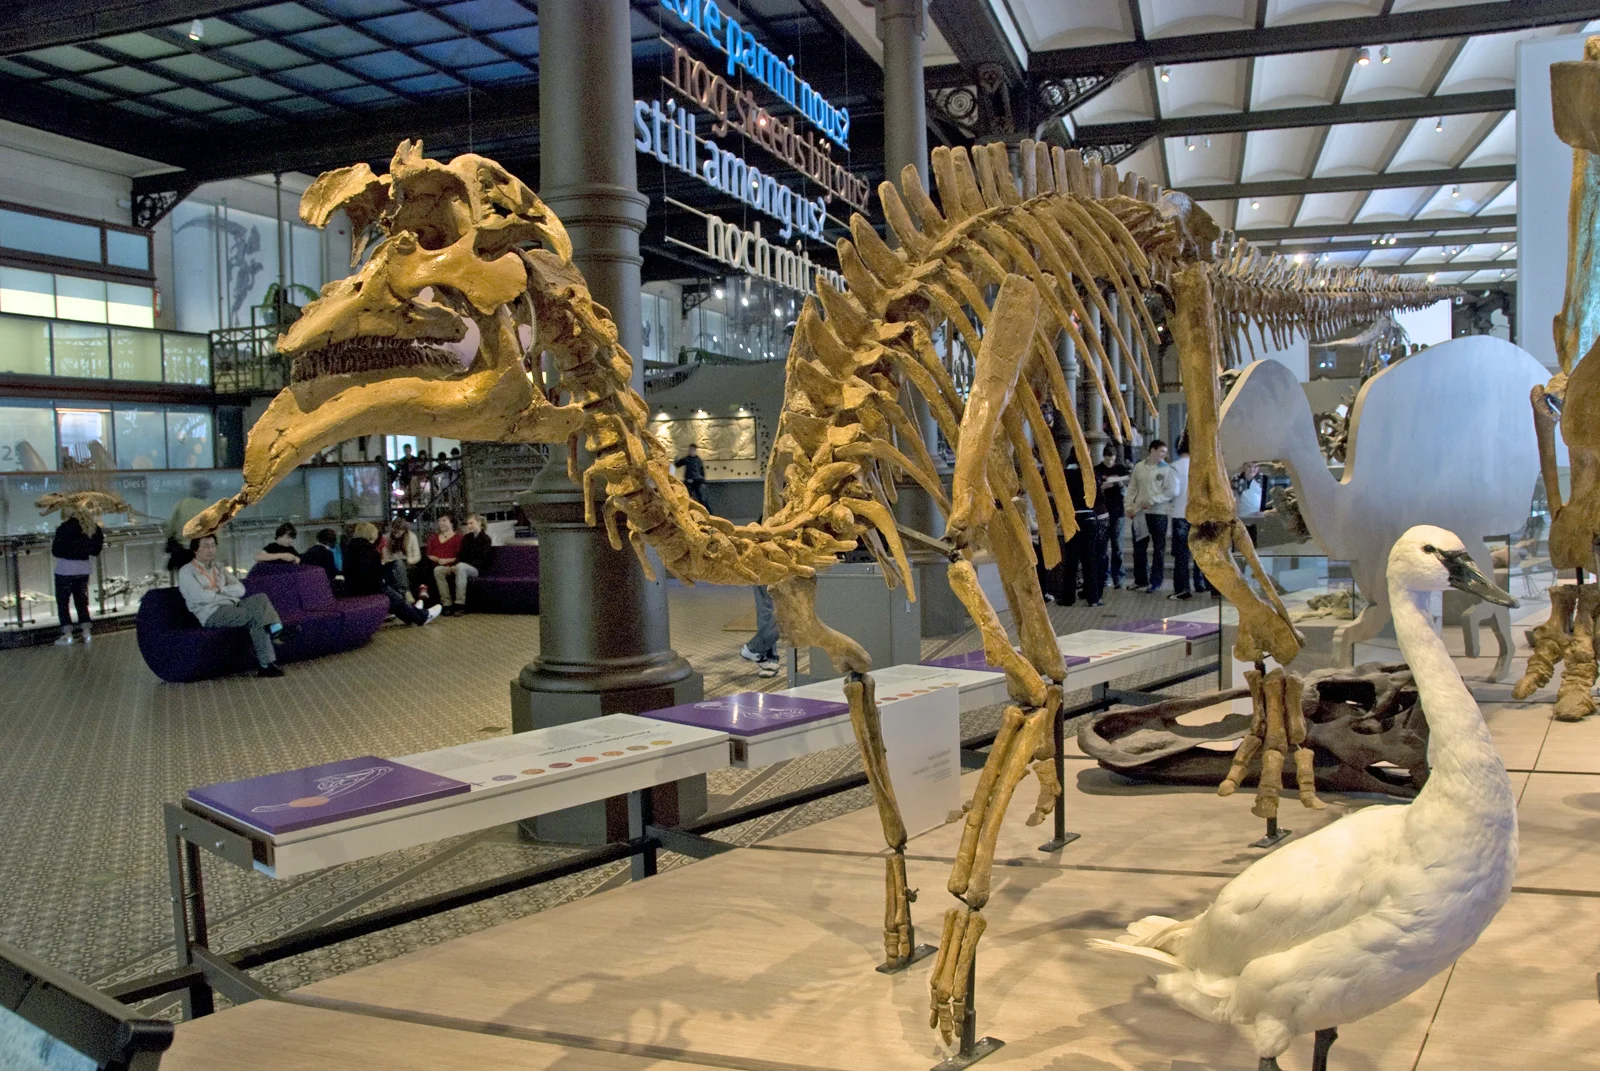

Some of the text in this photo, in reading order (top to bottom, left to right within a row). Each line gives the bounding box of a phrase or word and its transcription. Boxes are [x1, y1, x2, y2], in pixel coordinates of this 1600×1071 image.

[674, 44, 871, 216] nog steeds bij ons?
[726, 16, 796, 108] parmi
[801, 80, 850, 150] nous?
[633, 98, 827, 242] still among us?
[707, 213, 771, 280] noch
[775, 239, 813, 296] mit
